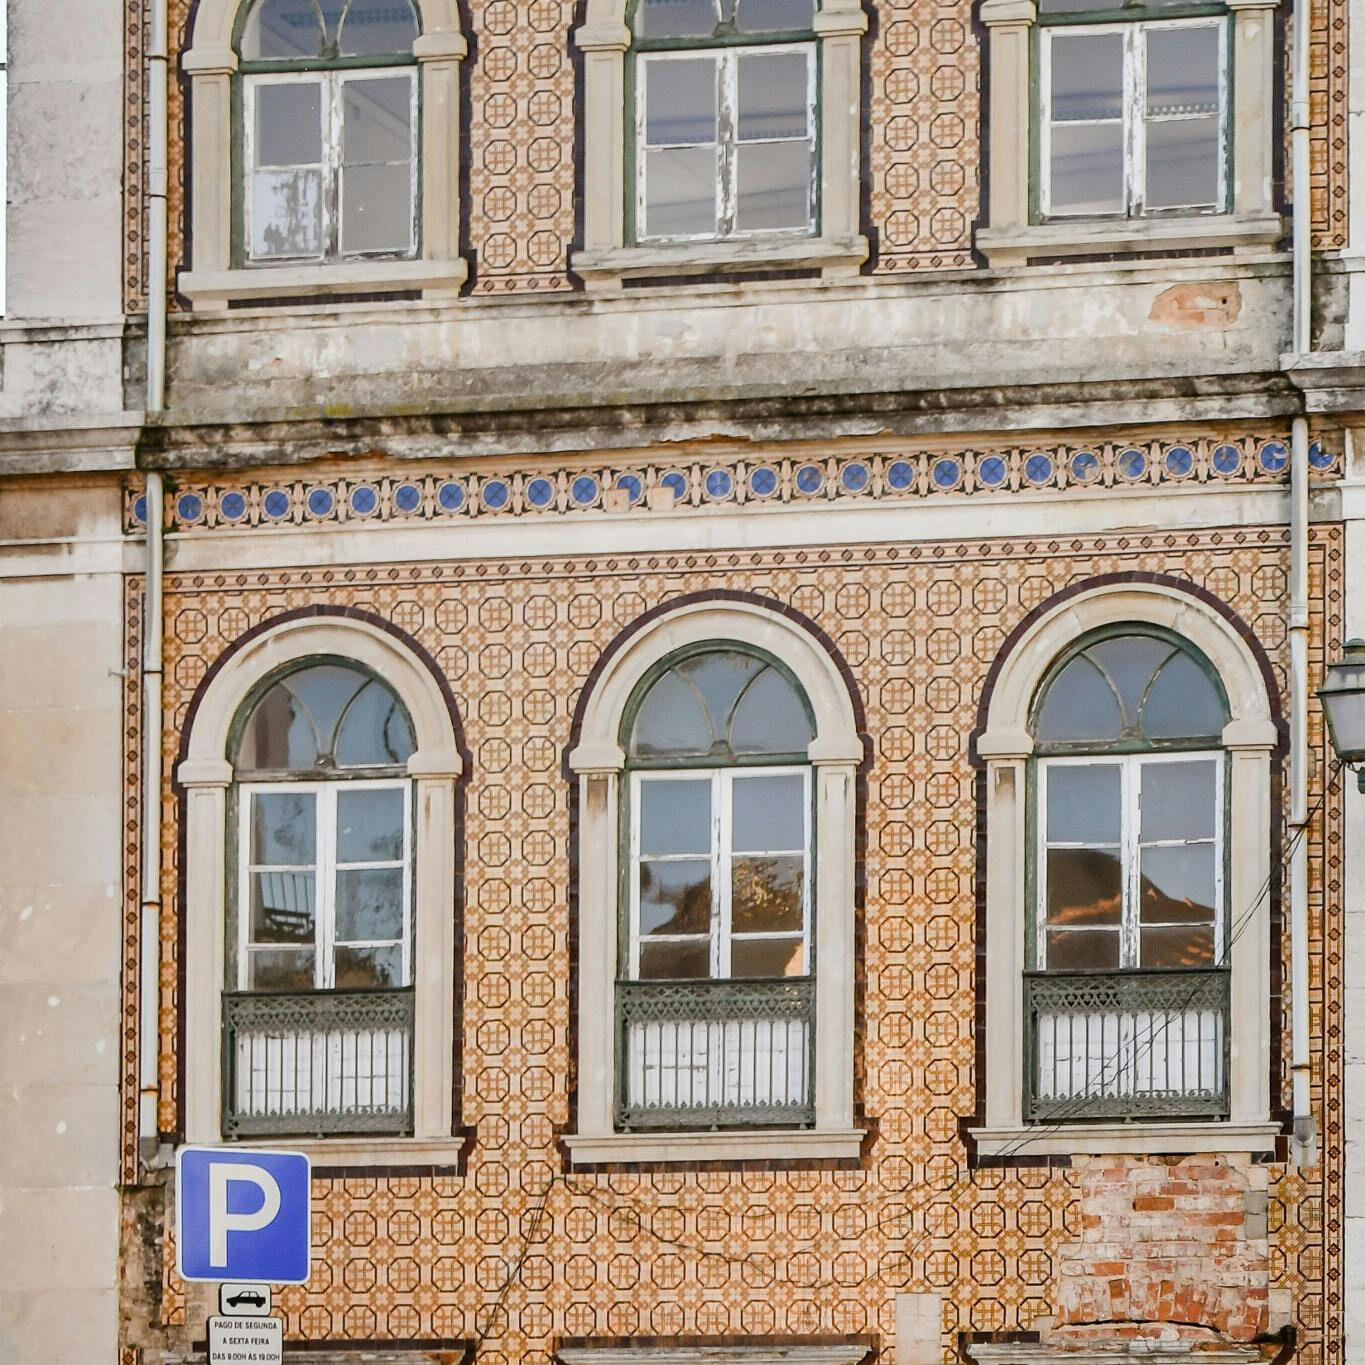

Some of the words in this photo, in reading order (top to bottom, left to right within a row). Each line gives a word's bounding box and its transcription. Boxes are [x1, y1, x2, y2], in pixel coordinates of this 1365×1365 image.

[209, 1162, 282, 1268] P
[214, 1321, 233, 1329] PAGO
[234, 1321, 243, 1329] DE
[245, 1321, 278, 1330] SEGUNDA
[229, 1337, 250, 1345] SEXTA
[250, 1337, 270, 1345] FEIRA
[212, 1352, 226, 1361] DAS
